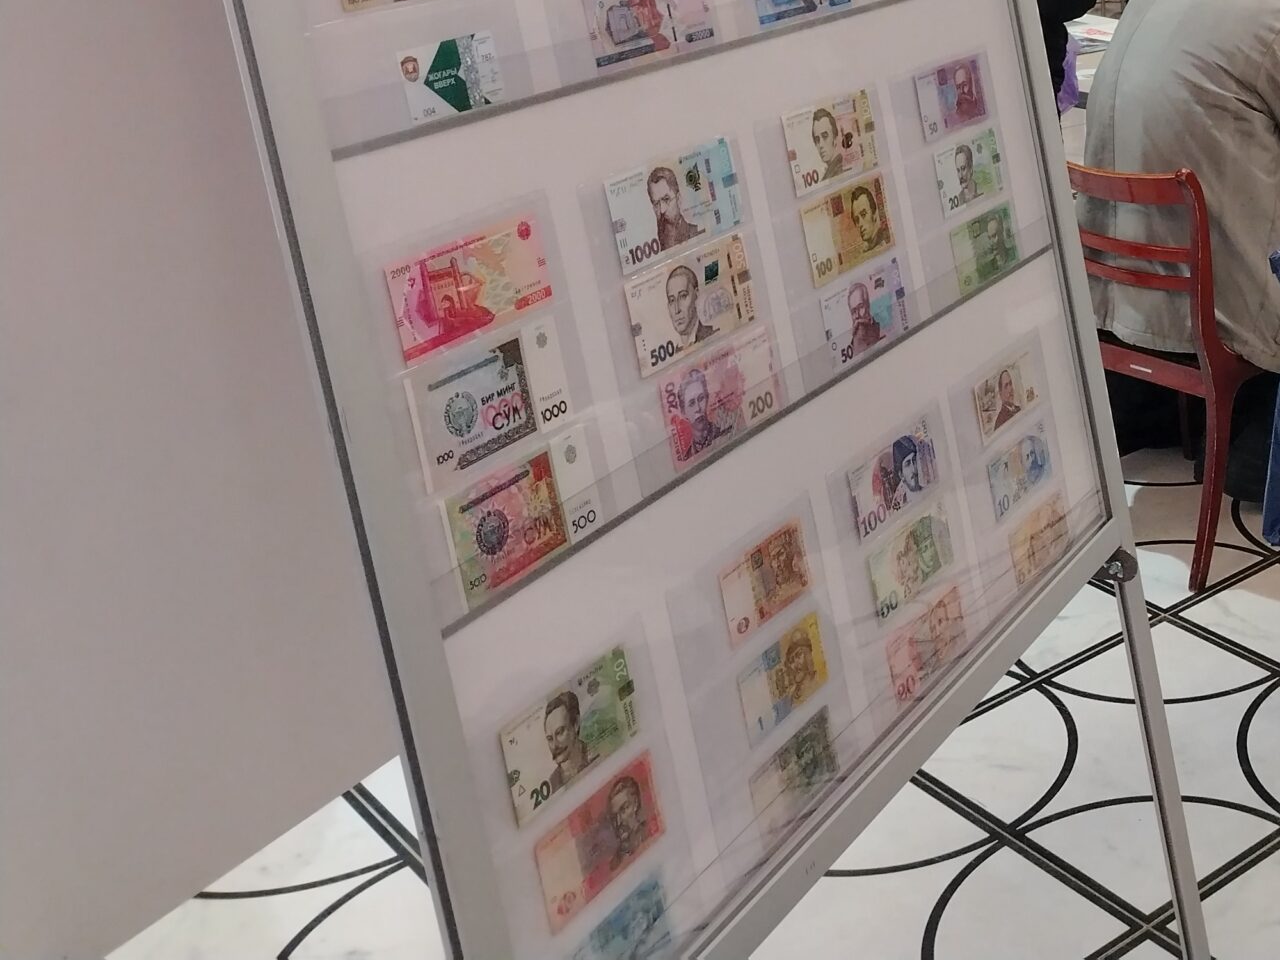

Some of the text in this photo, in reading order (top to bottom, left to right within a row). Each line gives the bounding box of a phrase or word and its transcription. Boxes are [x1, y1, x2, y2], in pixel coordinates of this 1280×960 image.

[433, 77, 456, 90] ВВЕРХ
[928, 122, 938, 135] 50
[802, 169, 819, 189] 100
[948, 195, 959, 211] 20
[628, 238, 660, 266] 1000
[390, 264, 411, 280] 2000
[815, 257, 833, 278] 100
[527, 290, 546, 305] 2000
[650, 340, 675, 367] 500
[841, 344, 854, 364] 50
[480, 382, 517, 406] БИР МИНГ
[665, 382, 679, 414] 200
[748, 391, 774, 419] 200
[541, 400, 568, 424] 1000
[436, 449, 454, 466] 1000
[998, 494, 1010, 516] 10
[571, 509, 597, 534] 500
[860, 503, 887, 538] 100
[469, 573, 487, 590] 500
[880, 590, 899, 619] 50
[614, 658, 627, 681] 20
[530, 780, 551, 811] 20
